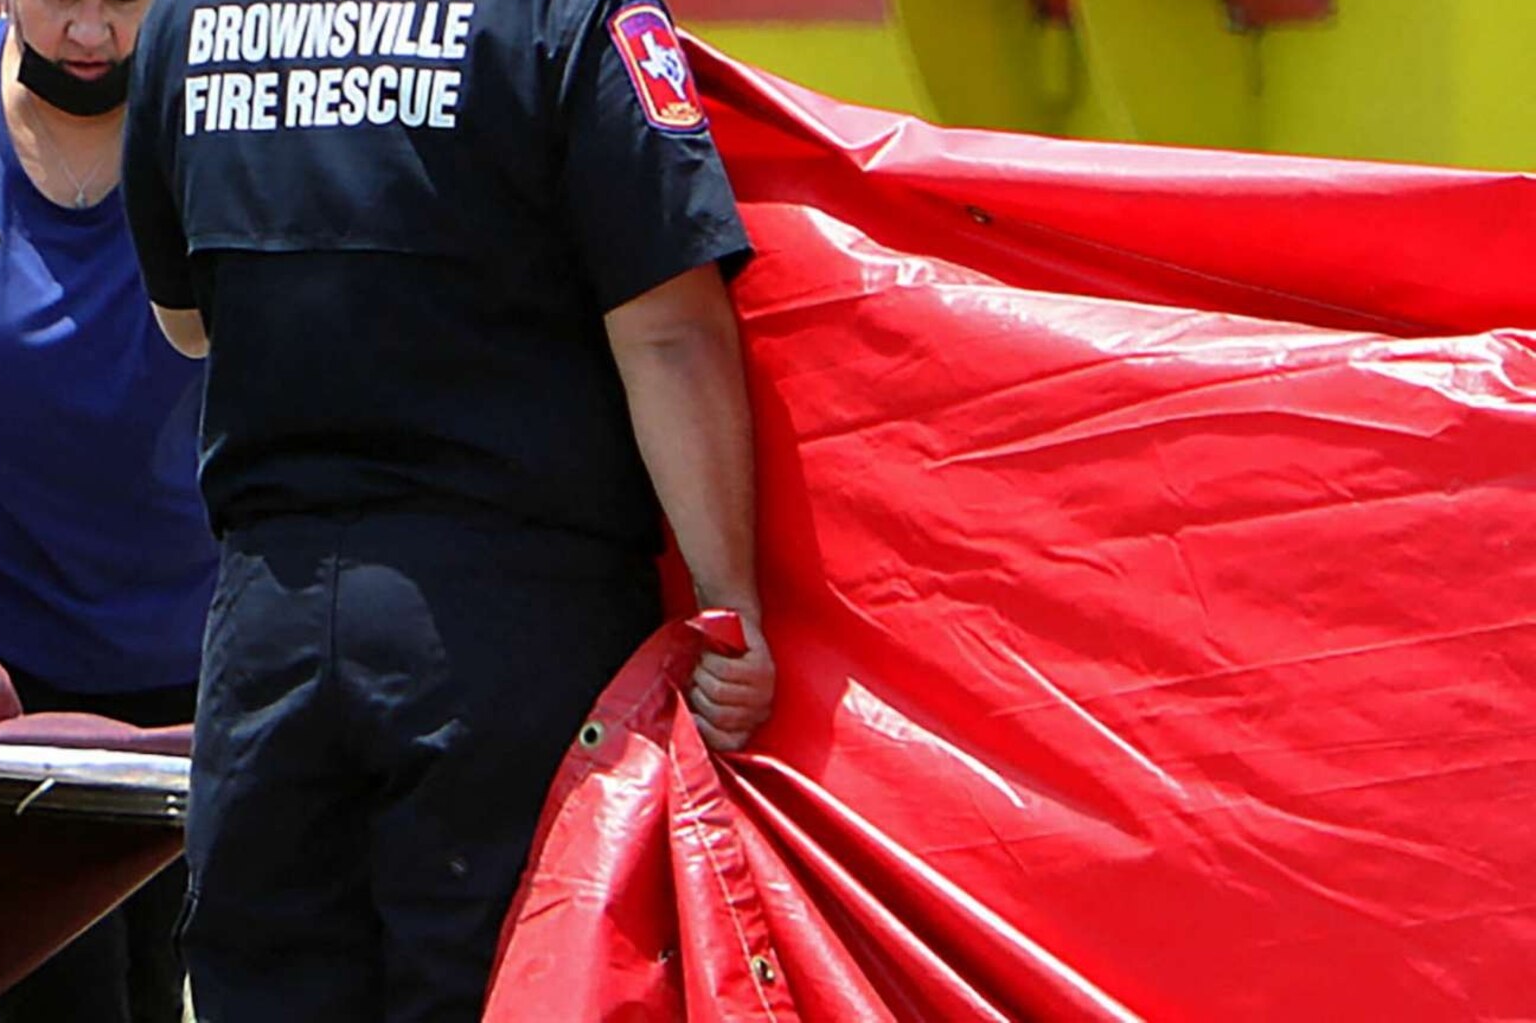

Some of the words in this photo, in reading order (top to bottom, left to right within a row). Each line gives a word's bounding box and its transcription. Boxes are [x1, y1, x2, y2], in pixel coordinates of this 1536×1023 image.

[188, 0, 474, 65] BROWNSVILLE
[185, 72, 279, 136] FIRE
[285, 65, 462, 128] RESCUE
